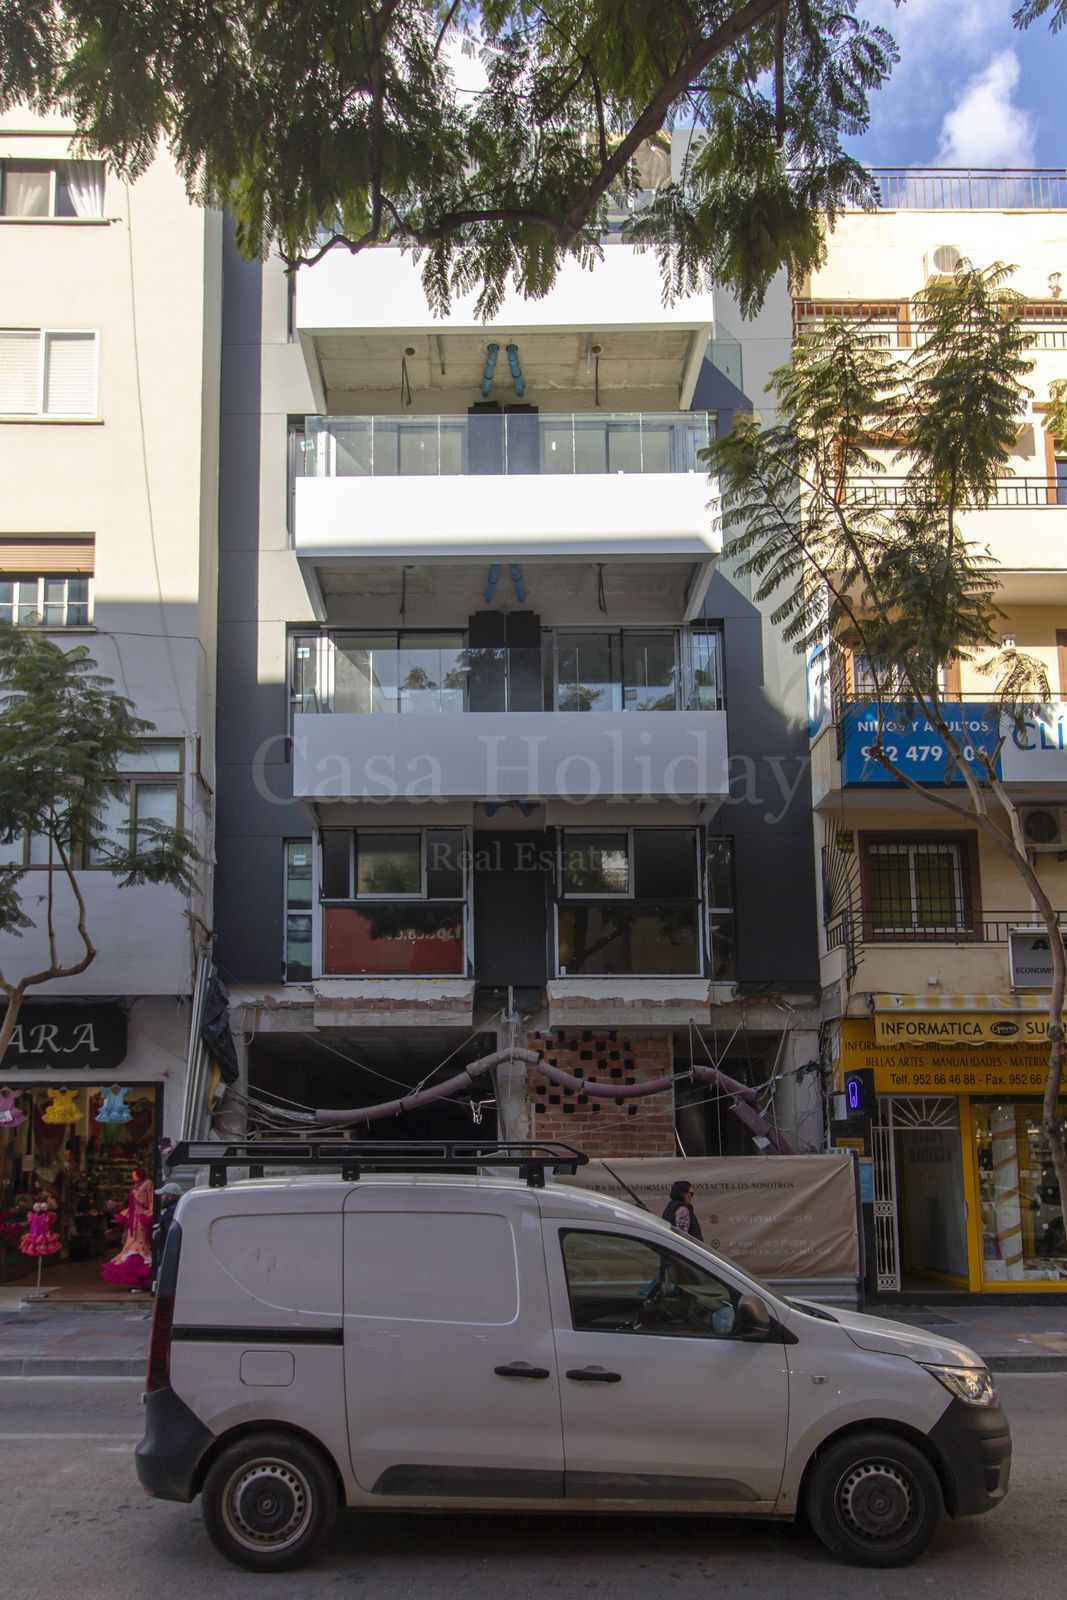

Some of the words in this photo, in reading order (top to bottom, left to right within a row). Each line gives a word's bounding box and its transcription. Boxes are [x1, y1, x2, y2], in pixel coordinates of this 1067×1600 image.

[911, 721, 918, 731] Y
[923, 721, 989, 732] AULTOS
[906, 745, 943, 762] 479
[881, 1022, 983, 1035] INFORMATICA
[866, 1057, 895, 1067] BELLAS
[898, 1057, 924, 1067] ARTES
[932, 1057, 1002, 1067] MANUALIDADES
[1010, 1057, 1050, 1067] MATERIA
[891, 1074, 911, 1085] Telf.
[914, 1074, 931, 1085] 952
[934, 1074, 946, 1085] 66
[950, 1074, 962, 1085] 46
[964, 1074, 976, 1085] 88
[986, 1074, 1007, 1085] Fax.
[1009, 1074, 1027, 1085] 952
[1029, 1074, 1042, 1085] 66
[731, 1182, 750, 1190] CON
[751, 1181, 795, 1190] NOSOTROS
